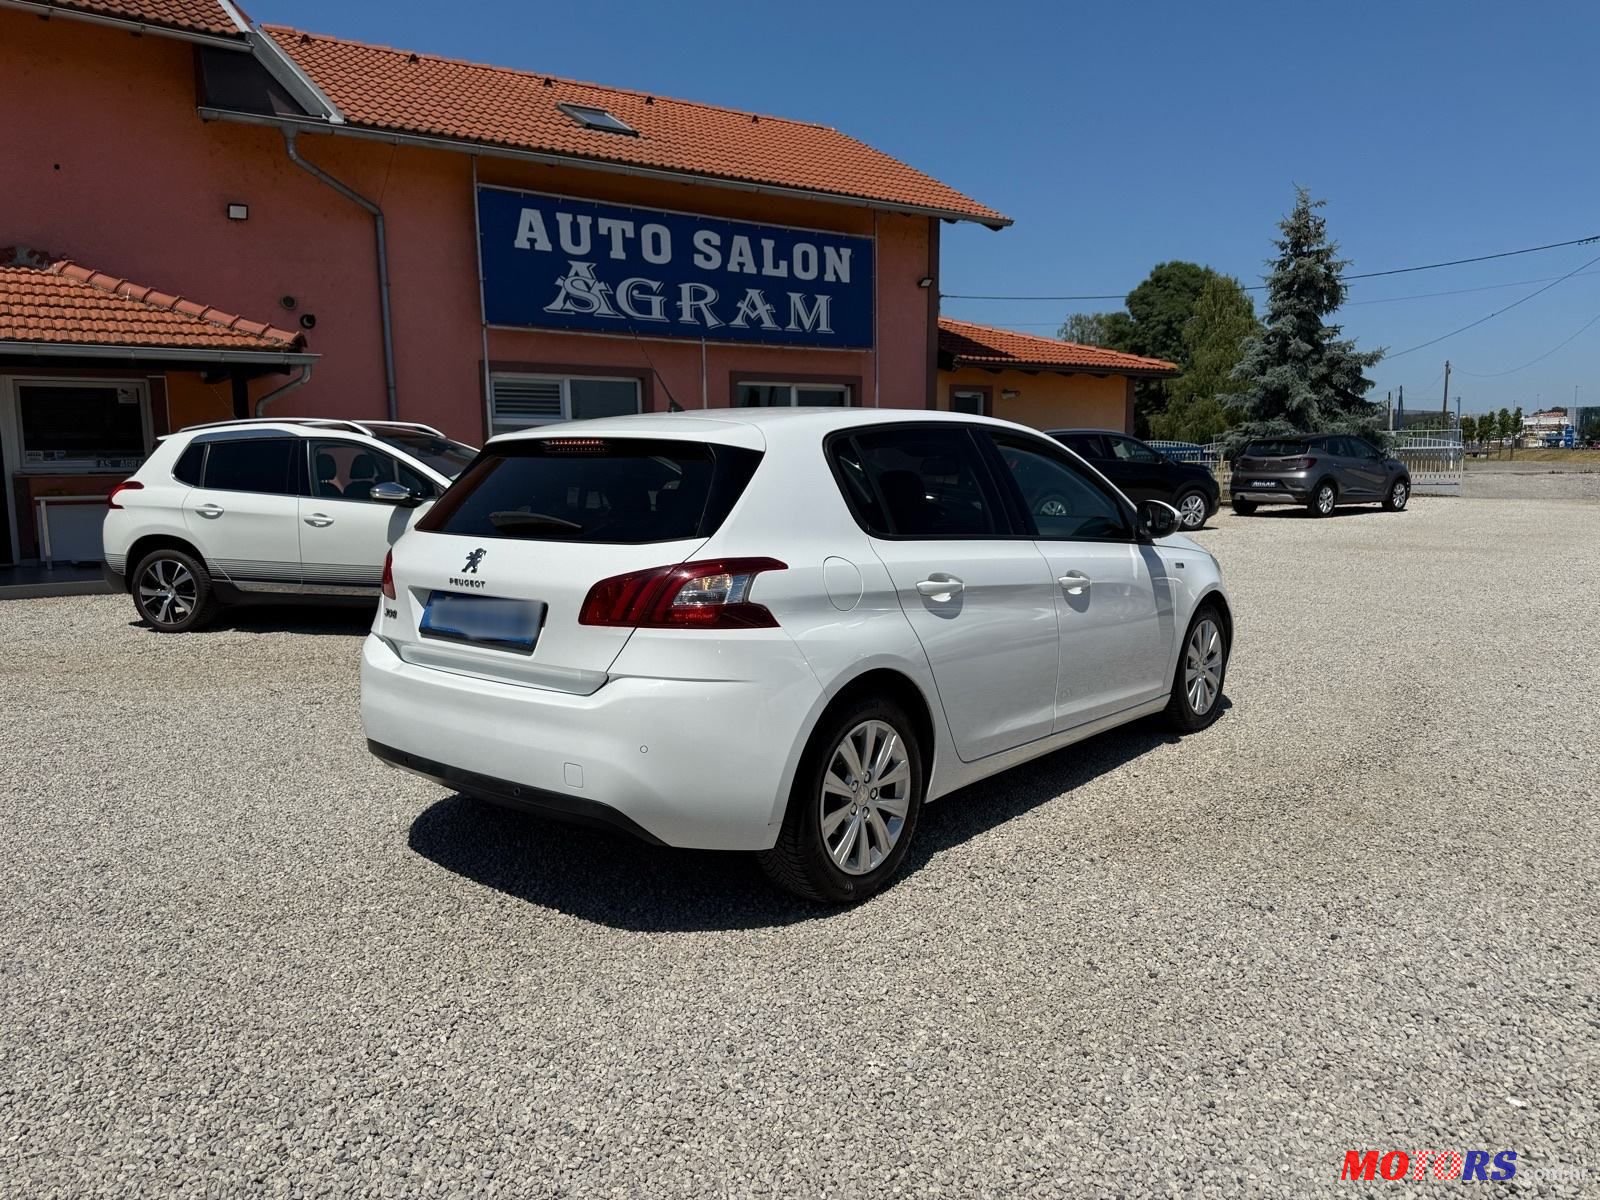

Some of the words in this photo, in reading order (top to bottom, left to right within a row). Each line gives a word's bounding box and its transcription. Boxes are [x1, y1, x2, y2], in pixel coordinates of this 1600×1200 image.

[514, 208, 672, 265] AUTO
[693, 230, 852, 284] SALON
[448, 577, 486, 589] PEUGEOT
